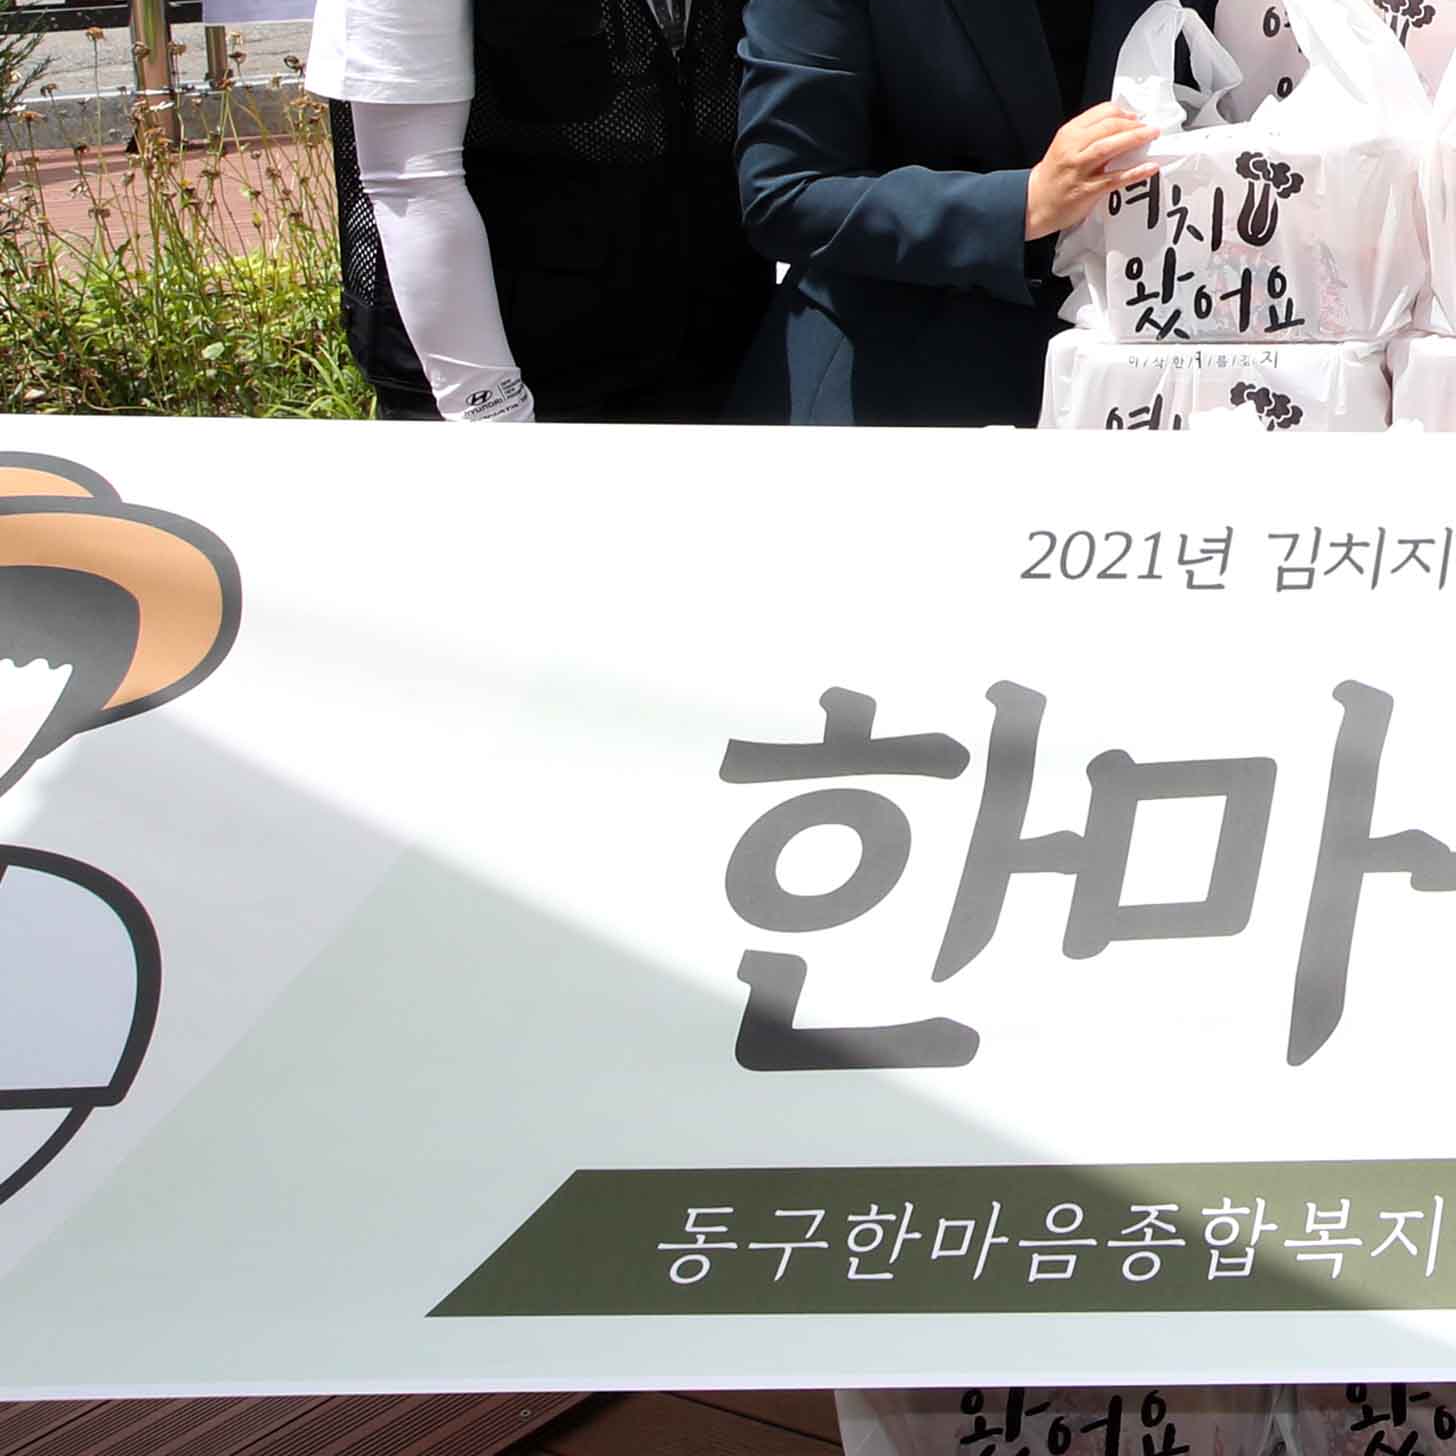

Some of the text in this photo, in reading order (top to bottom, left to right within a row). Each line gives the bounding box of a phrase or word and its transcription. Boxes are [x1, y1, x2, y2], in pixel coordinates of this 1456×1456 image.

[1109, 170, 1224, 252] 여치
[1125, 246, 1306, 340] 왔어요
[1020, 525, 1234, 592] 2021년
